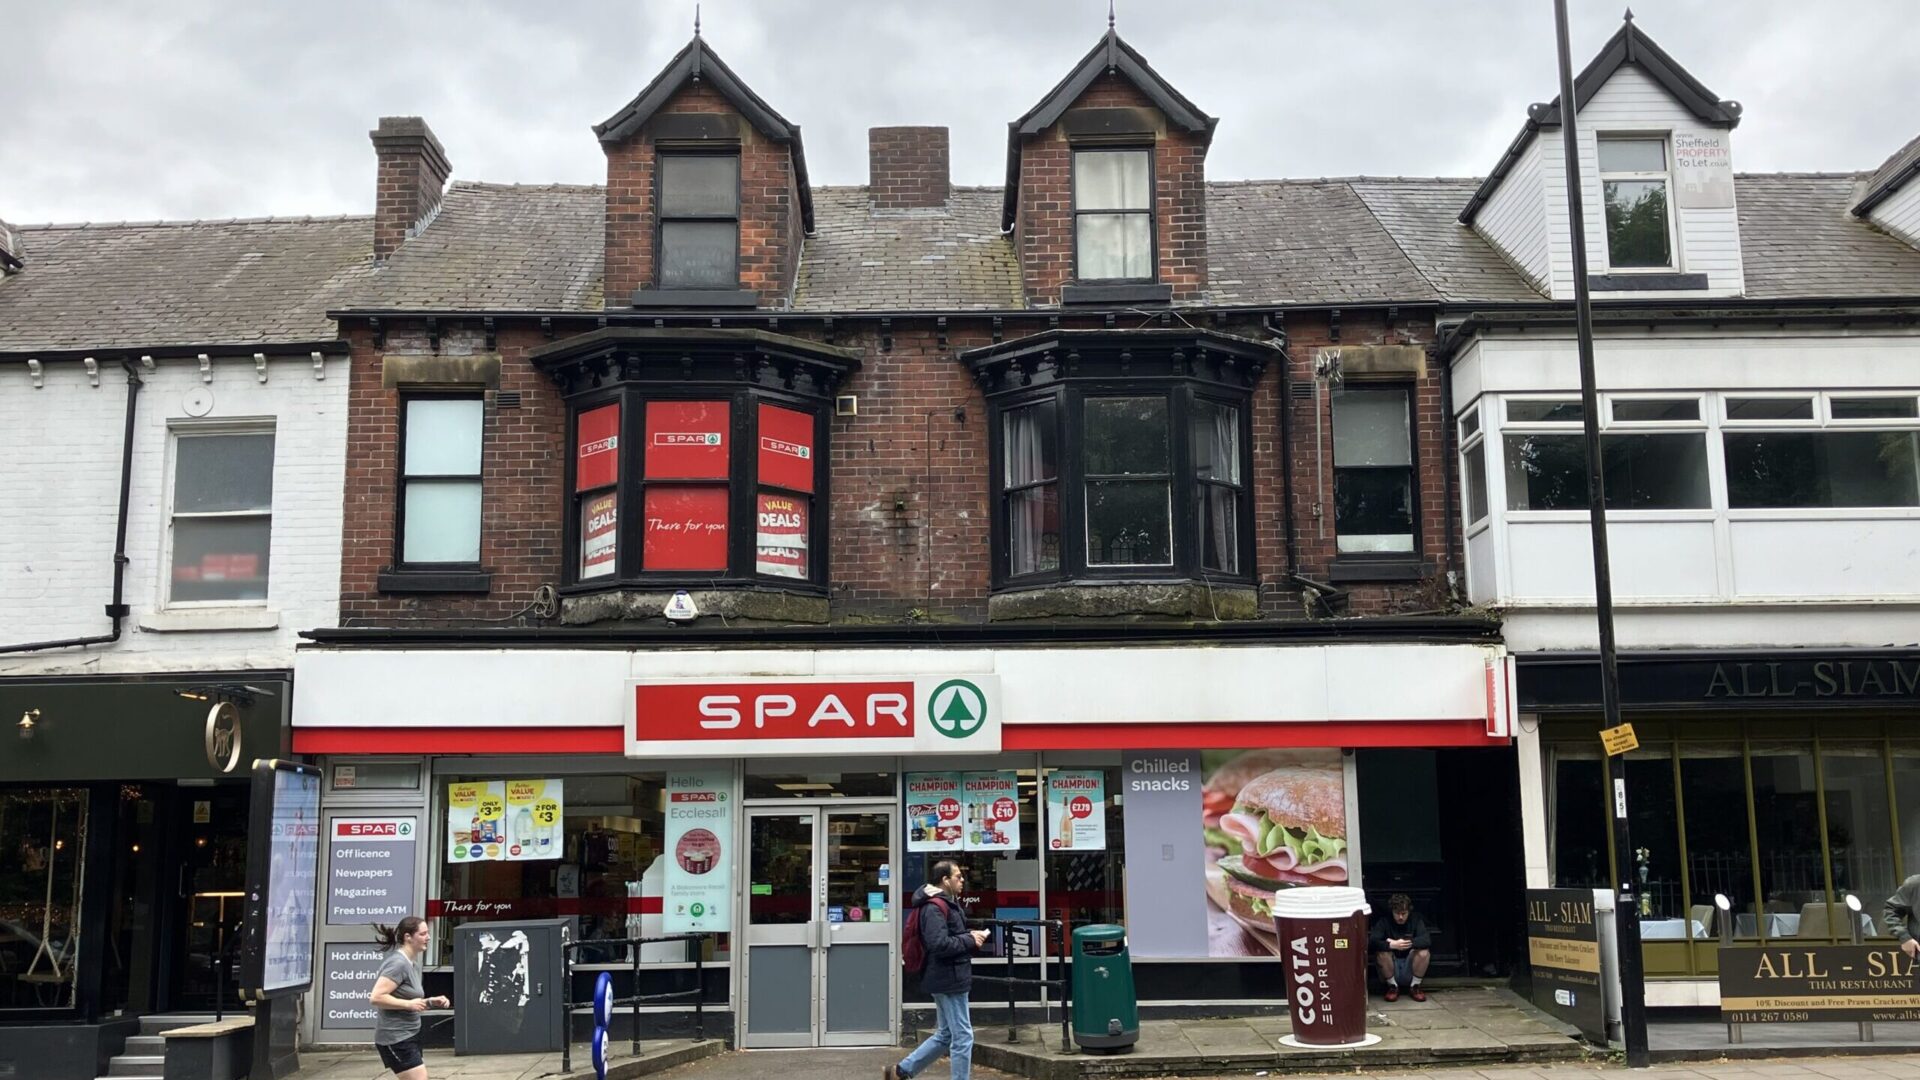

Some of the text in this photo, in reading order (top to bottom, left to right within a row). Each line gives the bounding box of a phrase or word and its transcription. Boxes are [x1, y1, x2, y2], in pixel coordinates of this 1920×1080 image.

[1676, 138, 1720, 148] Sheffield
[1677, 149, 1728, 158] PROPERTY
[1678, 158, 1690, 168] To
[1693, 158, 1708, 167] Let
[667, 435, 704, 443] SPAR
[587, 441, 608, 453] SPAR
[771, 441, 799, 453] SPAR
[592, 499, 613, 515] VALUE
[765, 500, 793, 511] VALUE
[588, 508, 617, 533] DEALS
[759, 512, 801, 528] DEALS
[648, 518, 726, 535] There for you
[699, 693, 907, 729] SPAR
[1131, 758, 1190, 773] Chilled
[671, 776, 704, 788] Hello
[909, 782, 958, 792] CHAMPION!
[965, 781, 1014, 791] CHAMPION!
[1052, 779, 1100, 789] CHAMPION!
[1131, 777, 1190, 792] snacks
[454, 790, 477, 798] VALUE
[510, 787, 535, 795] VALUE
[681, 793, 716, 801] SPAR
[480, 806, 502, 816] £3.99
[539, 811, 554, 822] £3
[671, 807, 726, 819] Ecclesall
[996, 807, 1014, 818] £10
[351, 825, 396, 834] SPAR
[336, 848, 391, 858] Off licence
[335, 868, 393, 879] Newpapers
[334, 887, 387, 899] Magazines
[444, 900, 512, 914] There for you
[962, 896, 980, 908] you
[333, 906, 355, 915] Free
[356, 906, 366, 914] to
[385, 906, 407, 914] ATM
[1529, 900, 1551, 922] ALL
[1560, 901, 1592, 924] SIAM
[331, 951, 384, 960] Hot drinks
[1754, 952, 1828, 979] ALL
[330, 970, 379, 980] Cold drin
[1314, 935, 1332, 1012] EXPRESS
[1290, 936, 1316, 1025] COSTA
[1808, 979, 1914, 990] THAI RESTAURANT
[1755, 999, 1772, 1007] 10%
[1774, 999, 1809, 1007] Discount
[1811, 999, 1826, 1007] and
[1828, 998, 1845, 1006] Free
[1847, 998, 1871, 1006] Prawn
[1873, 997, 1908, 1006] Crackers
[1731, 1012, 1757, 1022] 0114
[1760, 1012, 1780, 1021] 267
[1783, 1012, 1809, 1021] 0580
